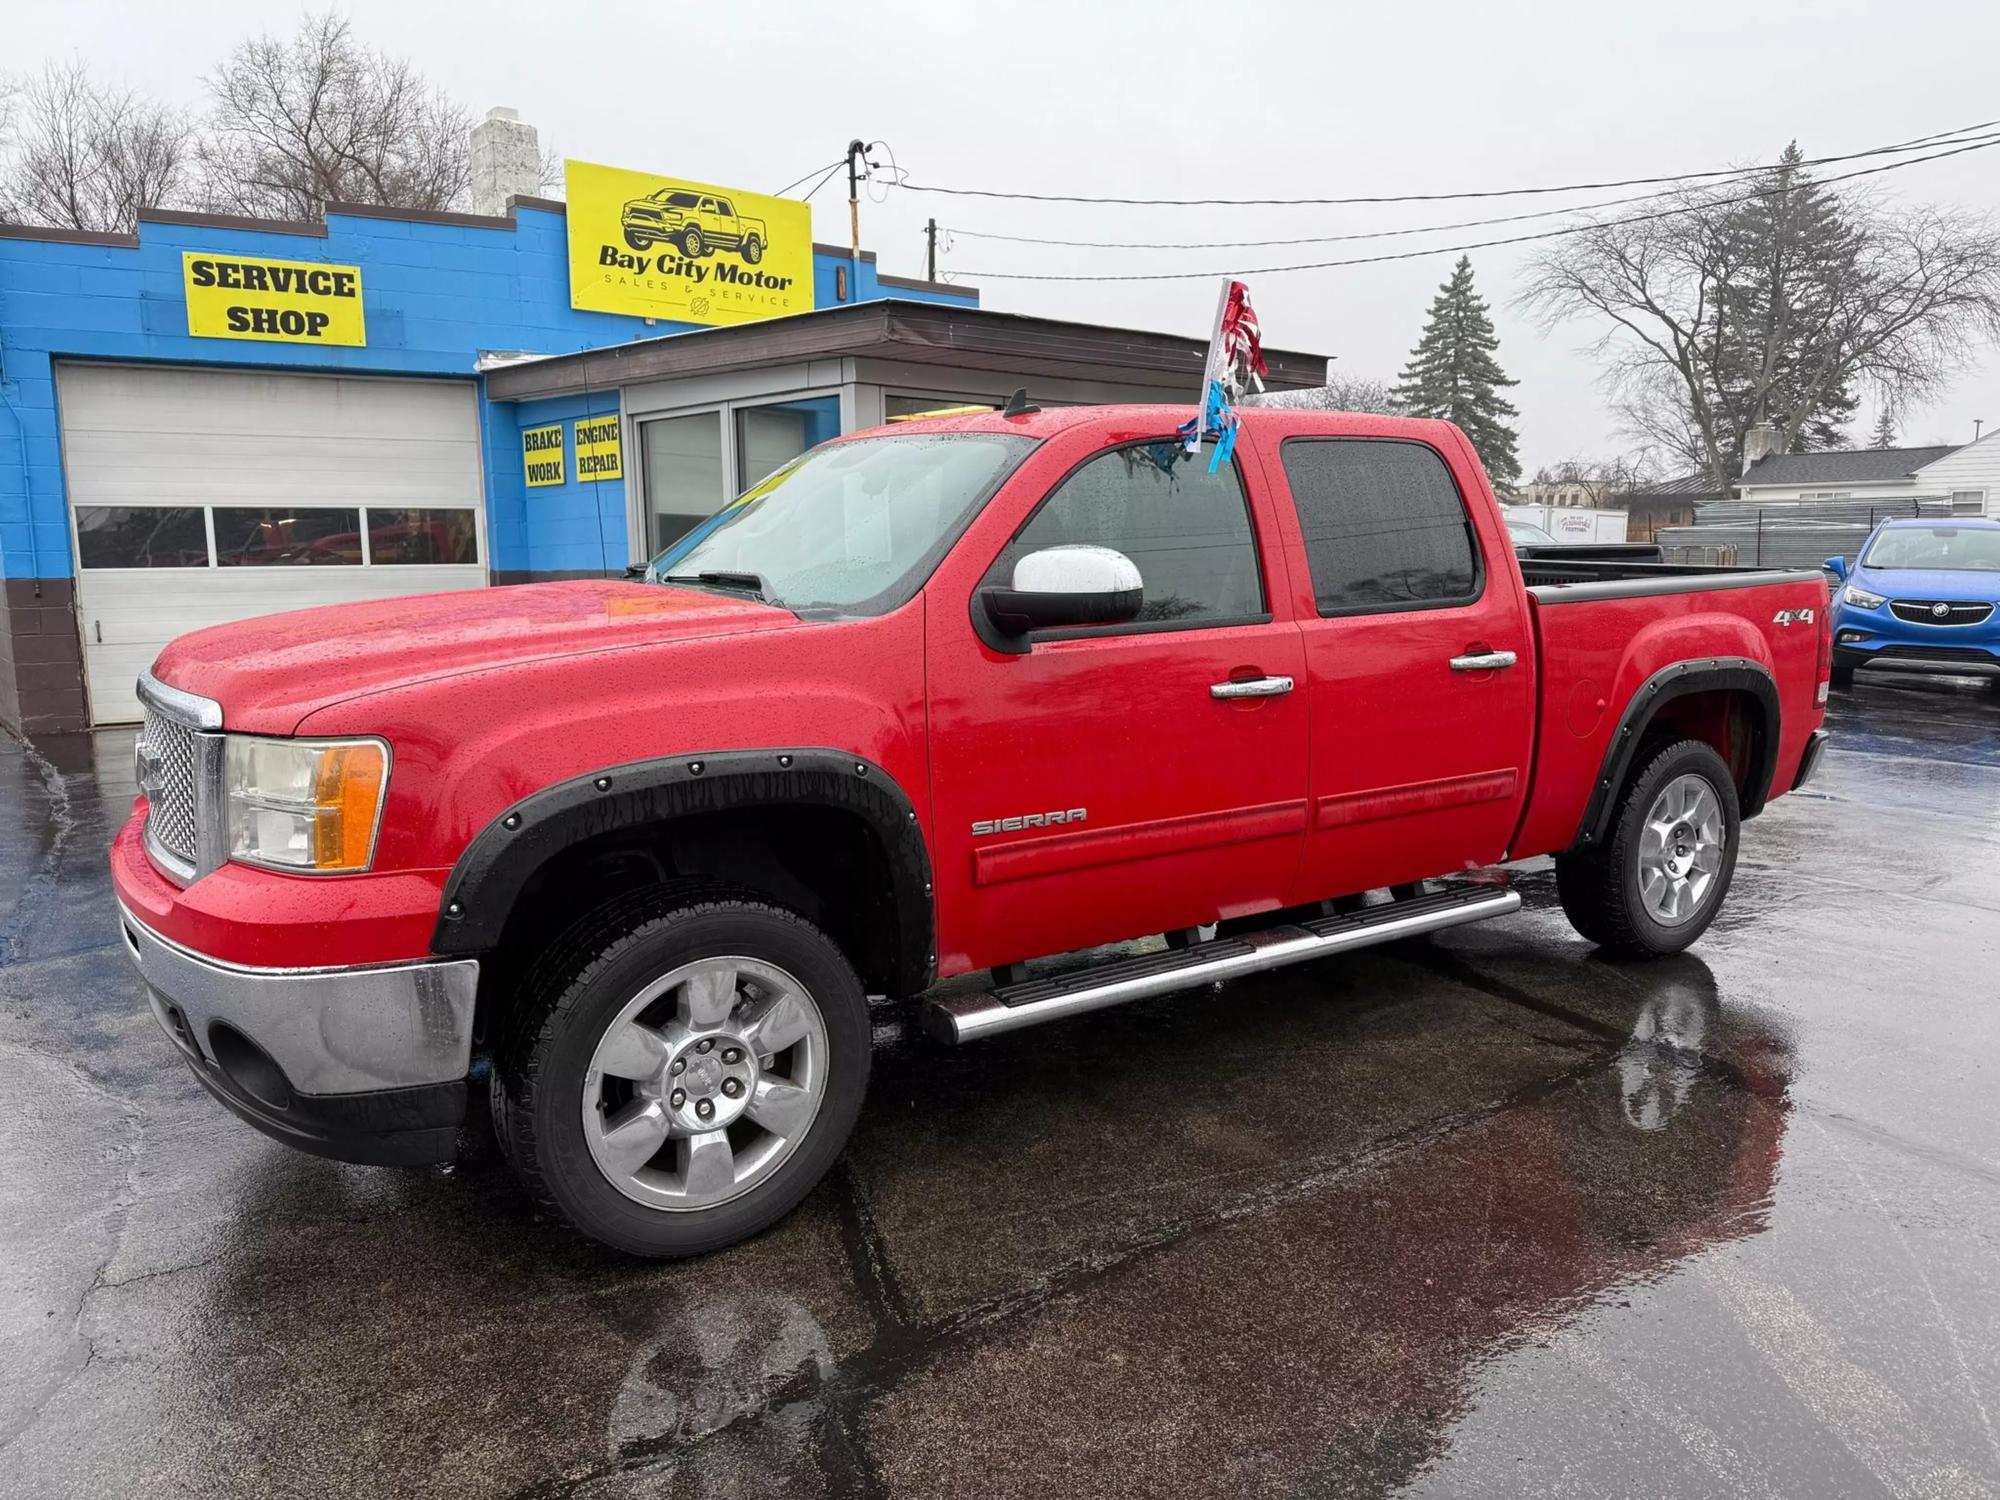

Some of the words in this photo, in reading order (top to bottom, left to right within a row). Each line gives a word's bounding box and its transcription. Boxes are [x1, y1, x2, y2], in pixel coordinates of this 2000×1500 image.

[191, 260, 356, 298] SERVICE
[599, 245, 651, 275] Bay
[656, 254, 709, 283] City
[714, 262, 792, 291] Motor
[604, 274, 668, 291] SALES
[710, 288, 789, 307] SERVICE
[226, 306, 330, 337] SHOP
[525, 430, 561, 452] BRAKE
[576, 423, 618, 446] ENGINE
[527, 462, 561, 482] WORK
[579, 454, 618, 474] REPAIR
[971, 807, 1087, 836] SIERRA
